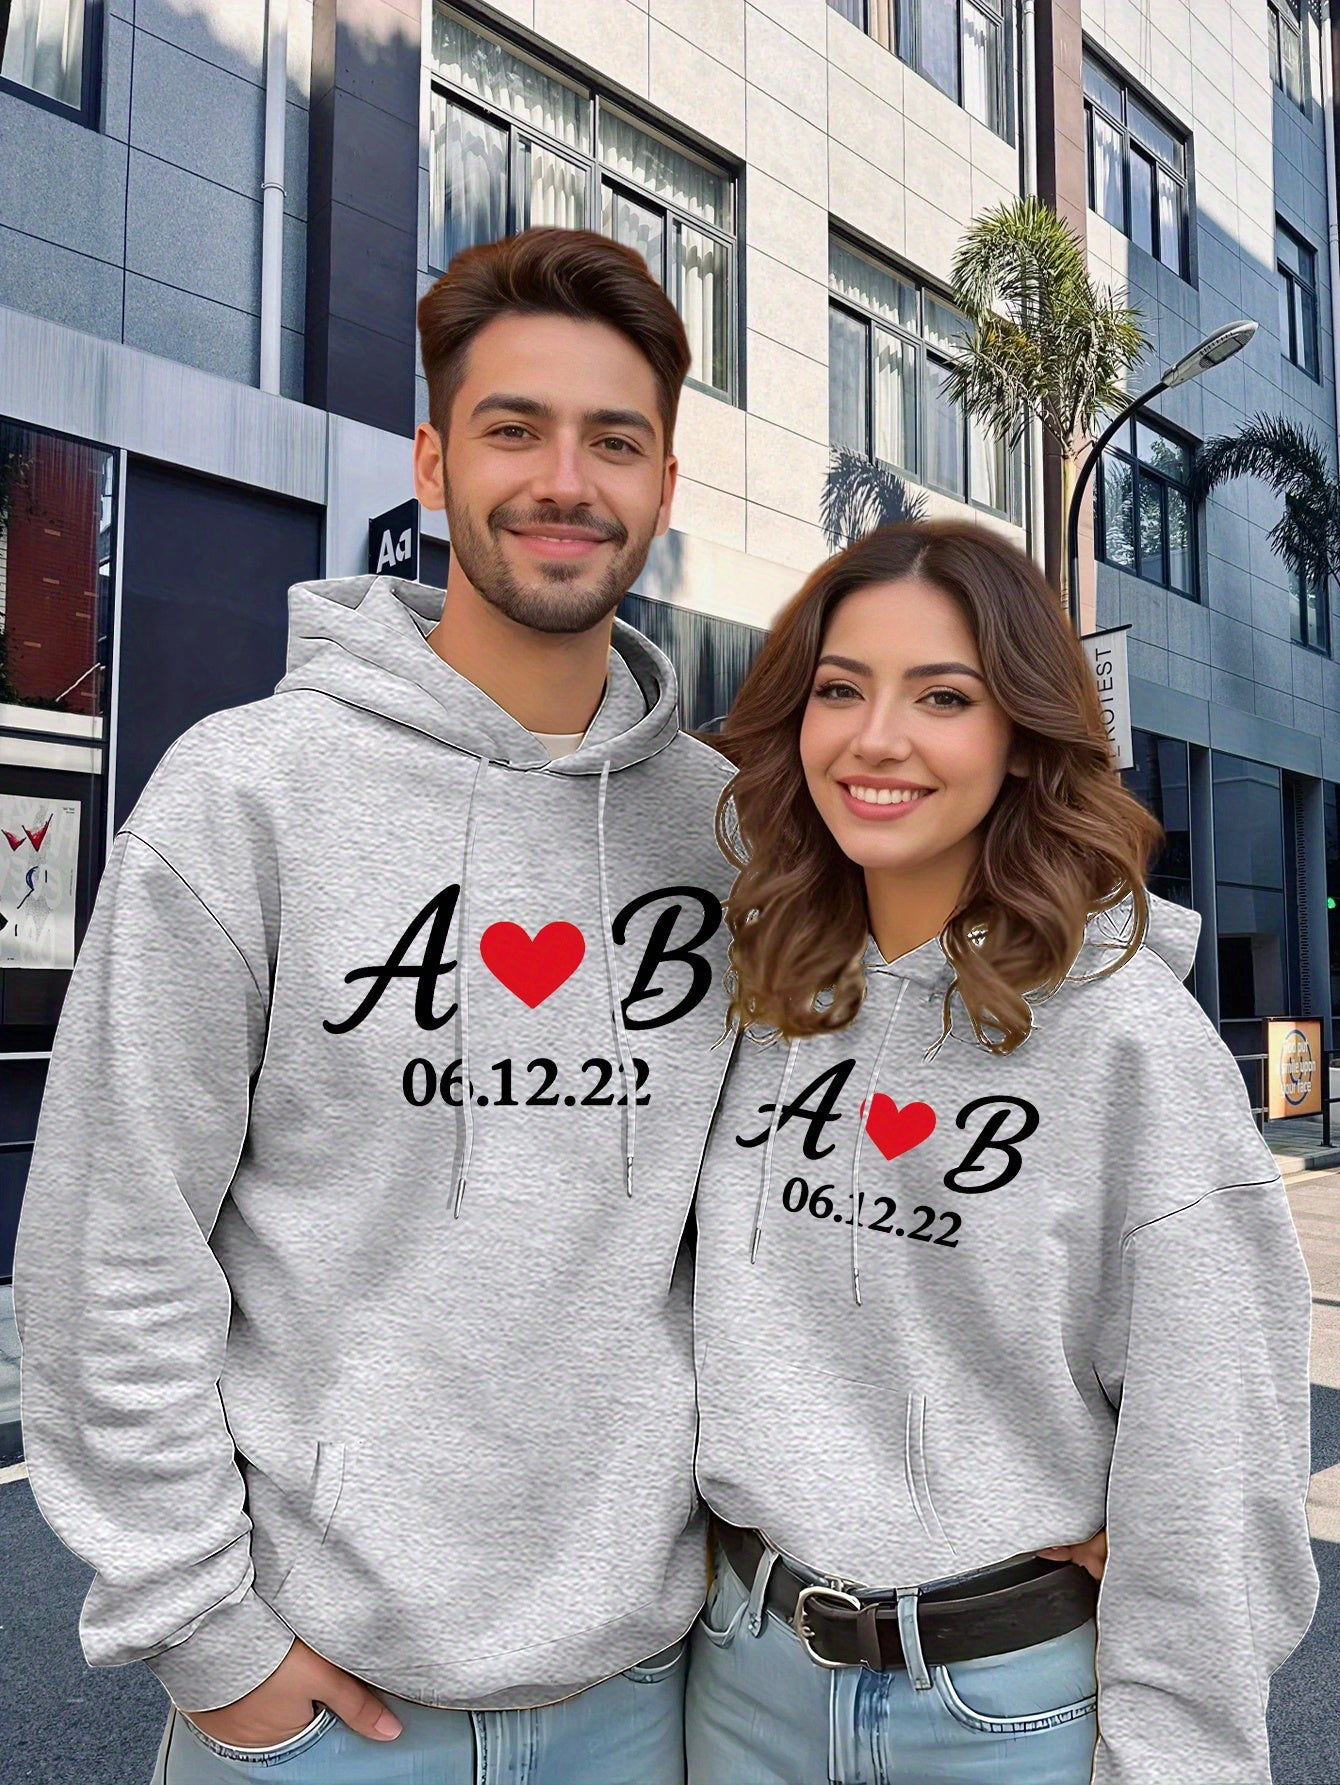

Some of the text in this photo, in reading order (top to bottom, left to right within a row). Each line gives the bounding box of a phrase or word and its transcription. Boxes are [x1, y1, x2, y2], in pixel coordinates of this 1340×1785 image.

[322, 883, 723, 1035] A B
[402, 1057, 652, 1107] 06.12.22
[735, 1058, 1040, 1194] A B
[1297, 1079, 1312, 1093] face
